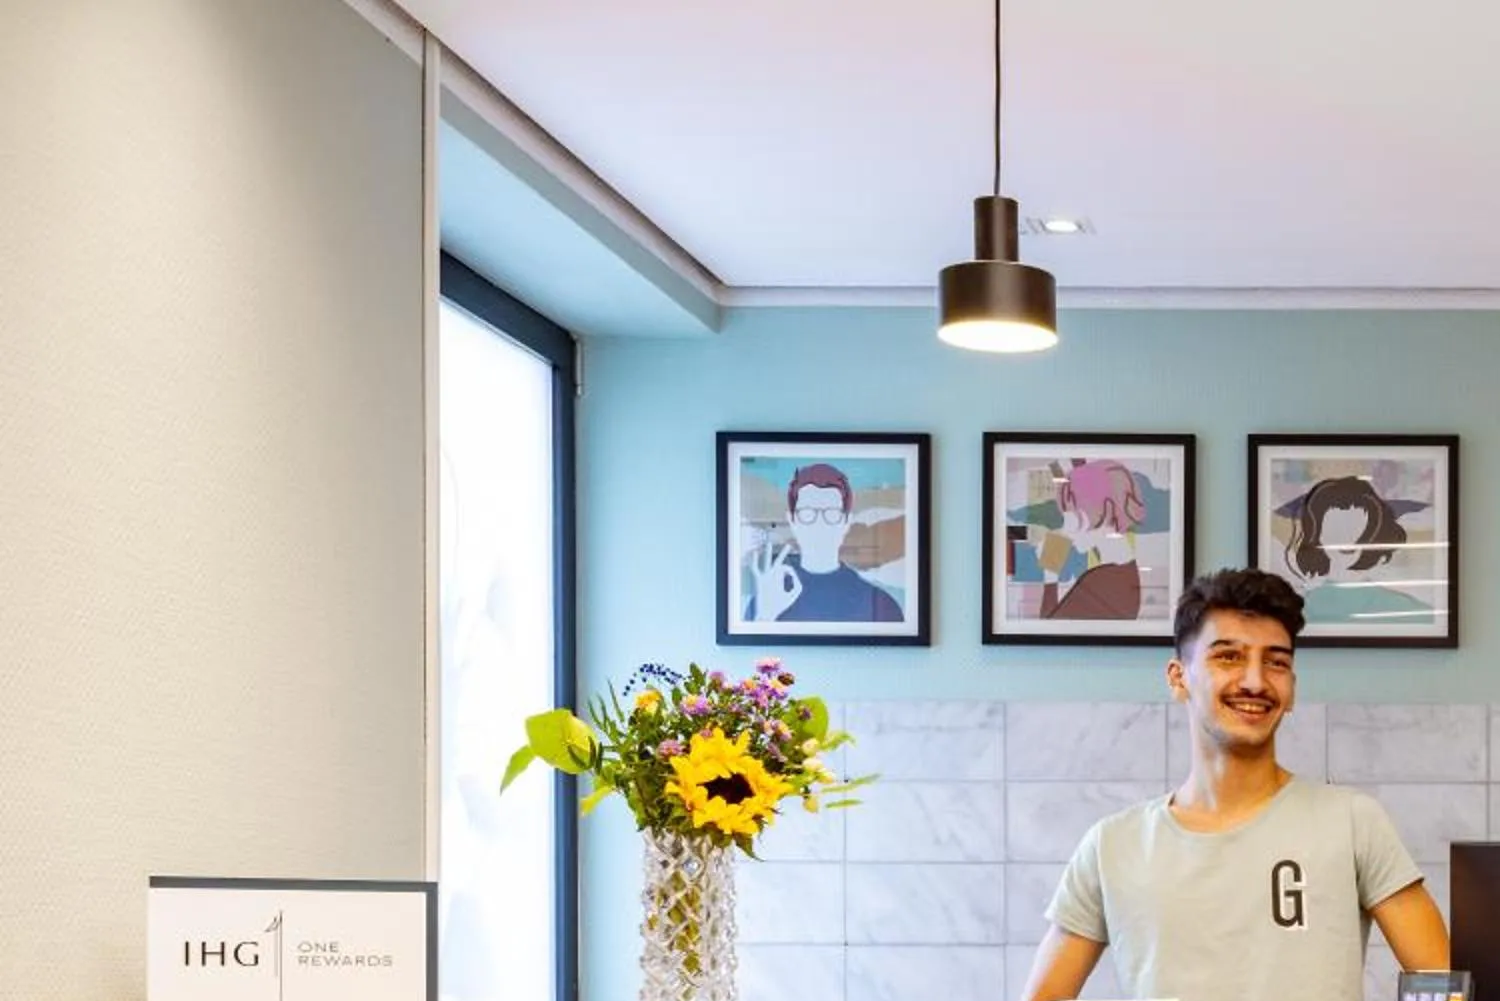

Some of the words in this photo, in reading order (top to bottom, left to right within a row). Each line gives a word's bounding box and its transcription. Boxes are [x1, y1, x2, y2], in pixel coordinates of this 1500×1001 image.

[1271, 859, 1304, 928] G
[184, 941, 260, 967] IHG
[297, 941, 340, 953] ONE
[298, 955, 394, 967] REWARDS
